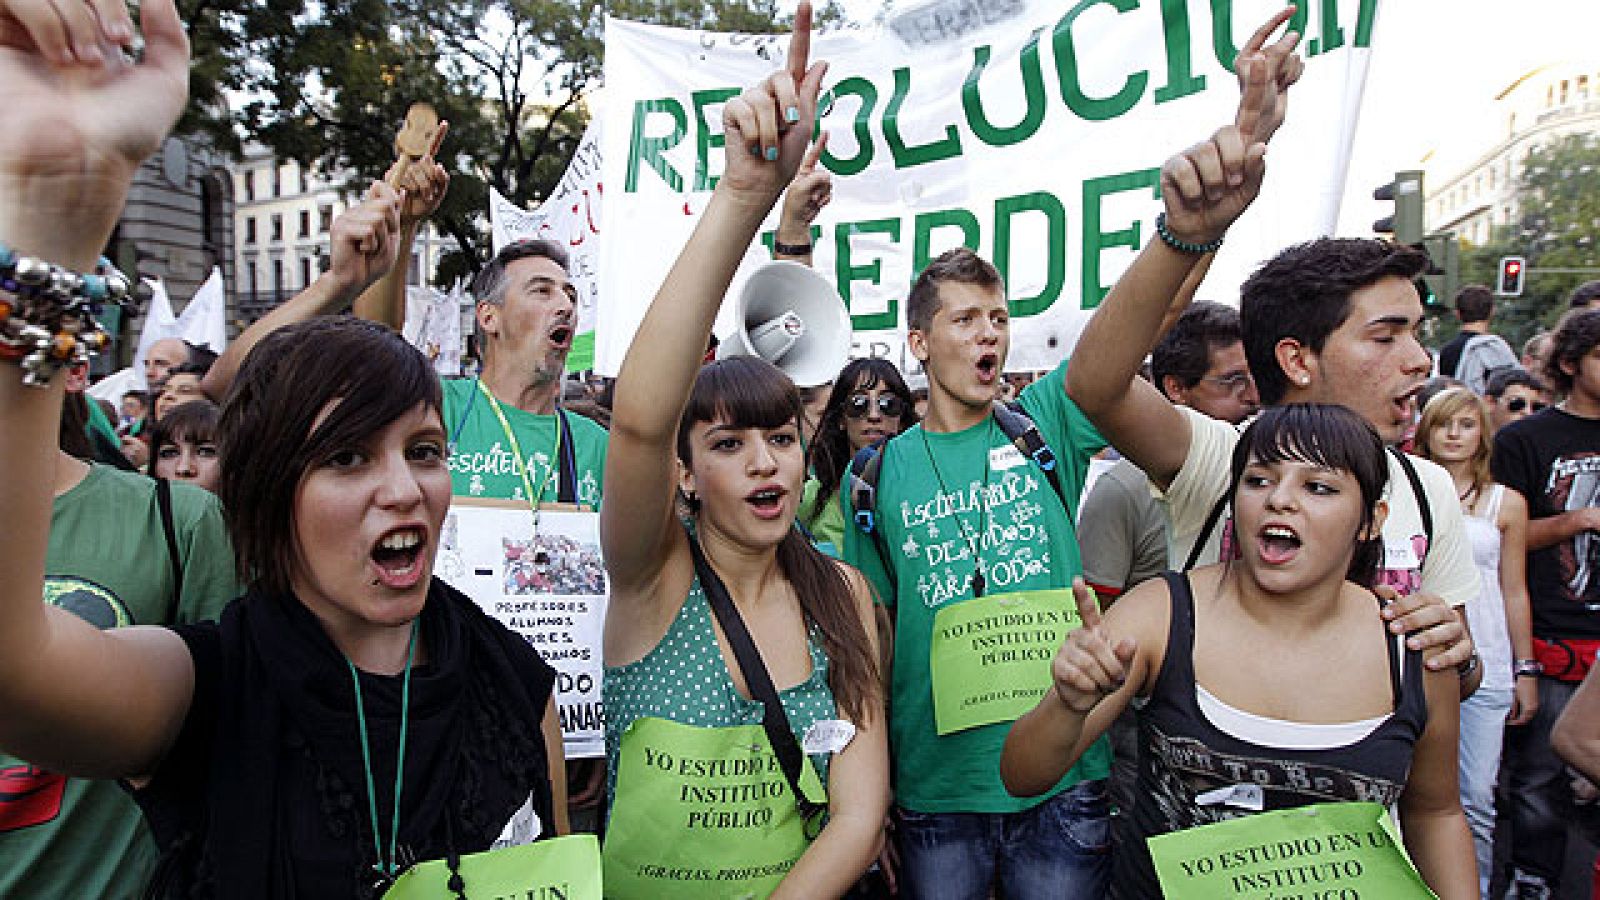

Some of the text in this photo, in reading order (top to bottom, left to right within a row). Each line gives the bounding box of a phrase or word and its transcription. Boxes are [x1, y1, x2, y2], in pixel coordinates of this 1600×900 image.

[494, 601, 589, 613] PROFESORES
[509, 616, 574, 629] ALUMNOS
[942, 624, 964, 640] YO
[966, 612, 1034, 636] ESTUDIO
[1036, 609, 1059, 626] EN
[971, 628, 1057, 651] INSTITUTO
[558, 671, 593, 694] DO
[644, 746, 674, 772] YO
[678, 756, 764, 779] ESTUDIO
[680, 779, 784, 804] INSTITUTO
[686, 805, 774, 830] PÚBLICO
[1180, 857, 1214, 878] YO
[1218, 837, 1322, 871] ESTUDIO
[1327, 831, 1362, 852] EN
[1231, 859, 1364, 894] INSTITUTO
